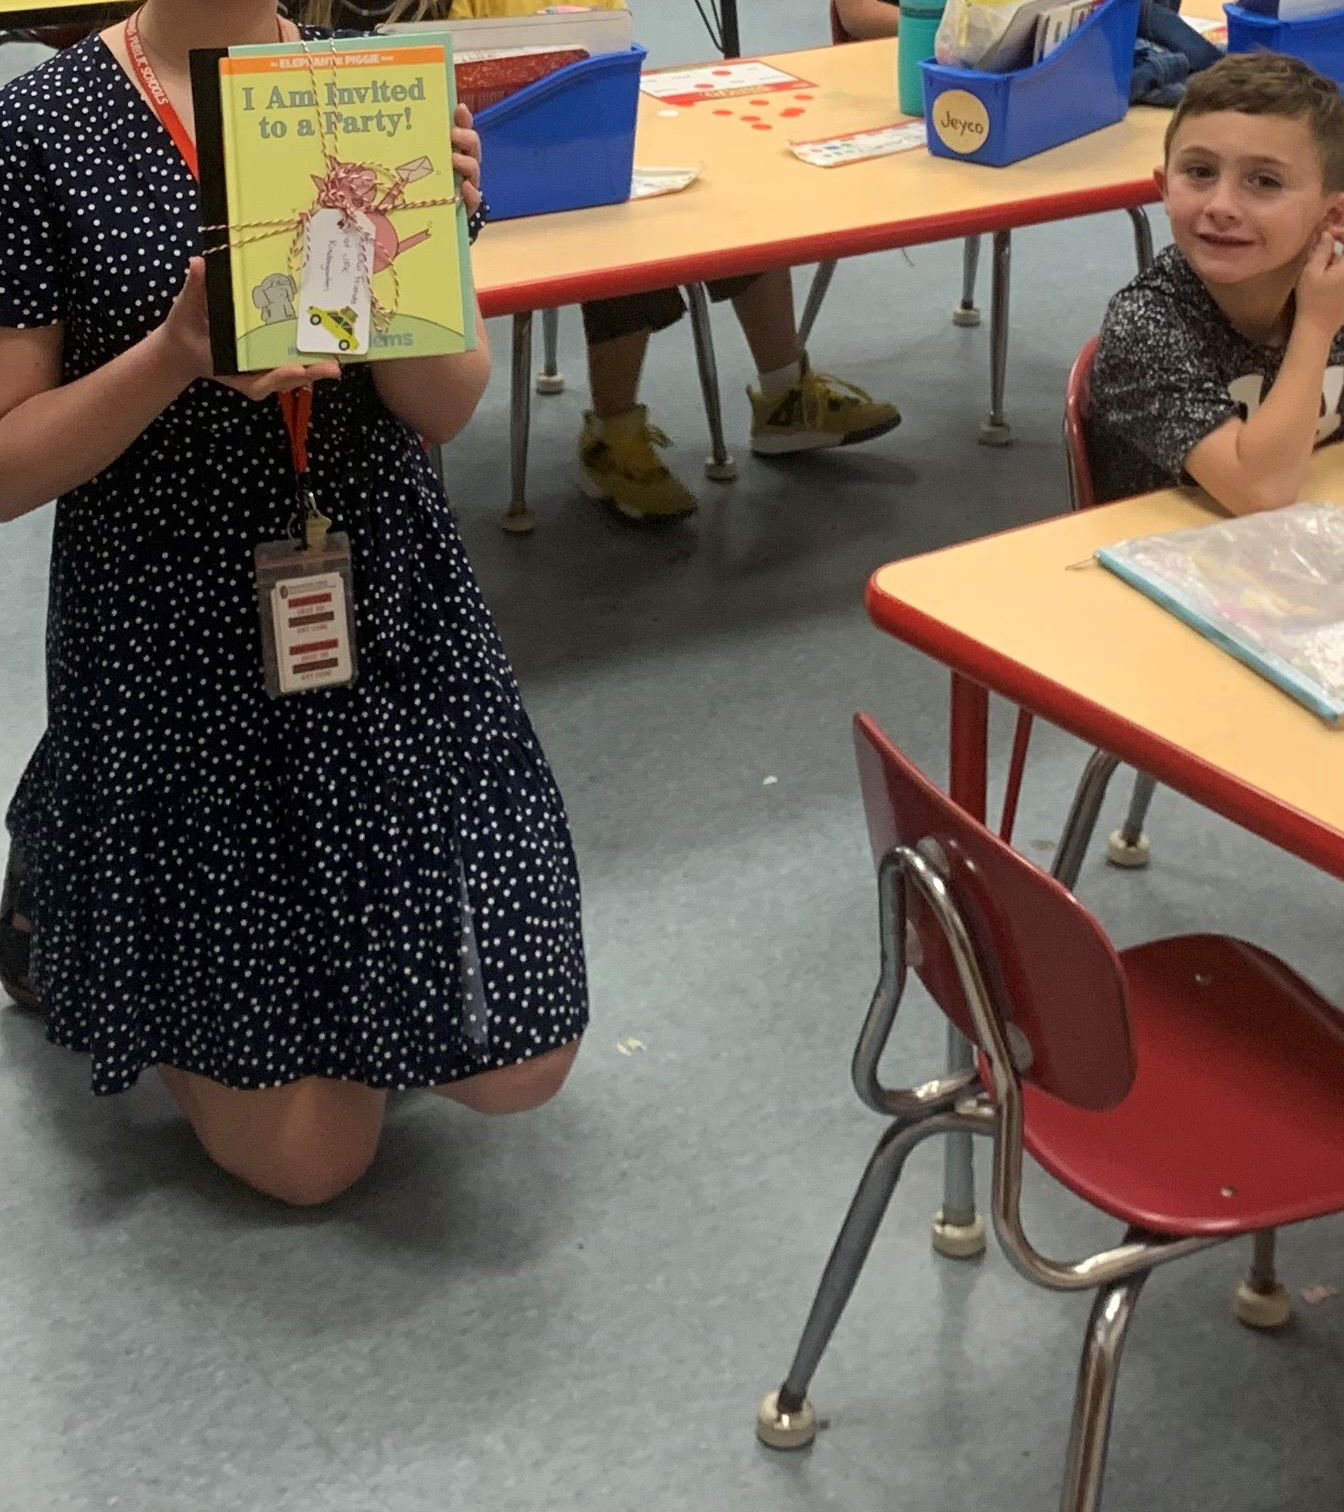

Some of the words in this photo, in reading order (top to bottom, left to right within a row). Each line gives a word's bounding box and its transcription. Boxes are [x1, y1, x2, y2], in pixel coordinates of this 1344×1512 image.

[129, 35, 149, 66] PUBLIC
[140, 66, 169, 105] SCHOOLS
[345, 53, 381, 65] PIGGIE
[242, 87, 256, 111] I
[266, 85, 319, 110] Am
[324, 76, 426, 106] Invited
[258, 116, 288, 139] to
[297, 119, 315, 137] a
[323, 106, 413, 138] Party!
[941, 110, 984, 136] Jeyco
